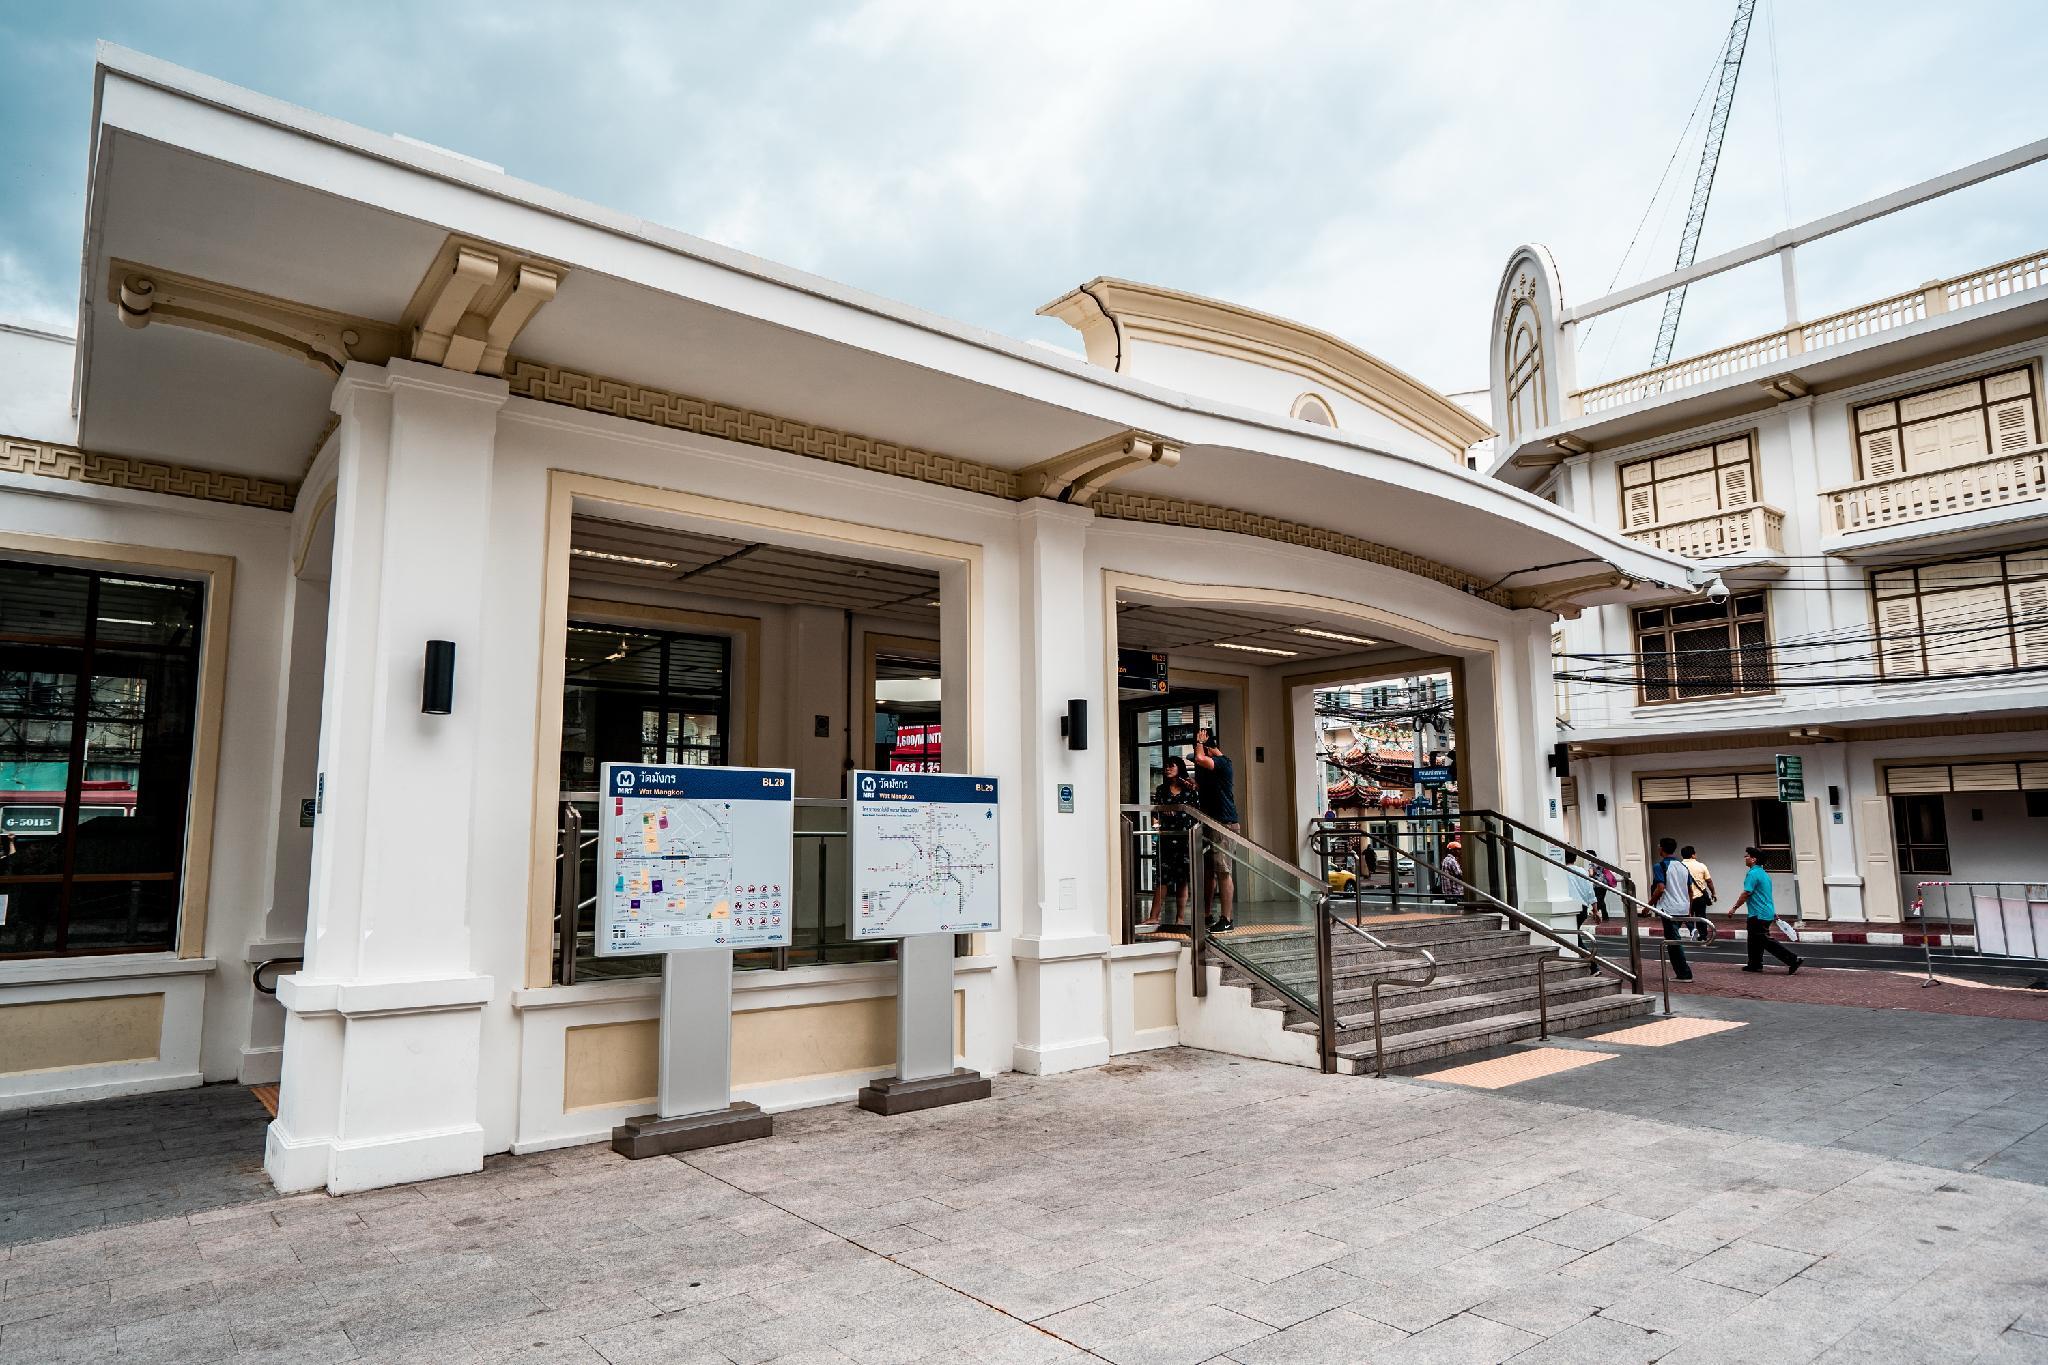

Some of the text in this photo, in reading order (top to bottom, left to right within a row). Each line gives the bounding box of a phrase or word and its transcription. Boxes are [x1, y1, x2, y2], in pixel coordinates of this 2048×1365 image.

[640, 771, 676, 784] วัดมังกร
[762, 777, 785, 787] BL.29
[653, 788, 684, 797] Mangkon
